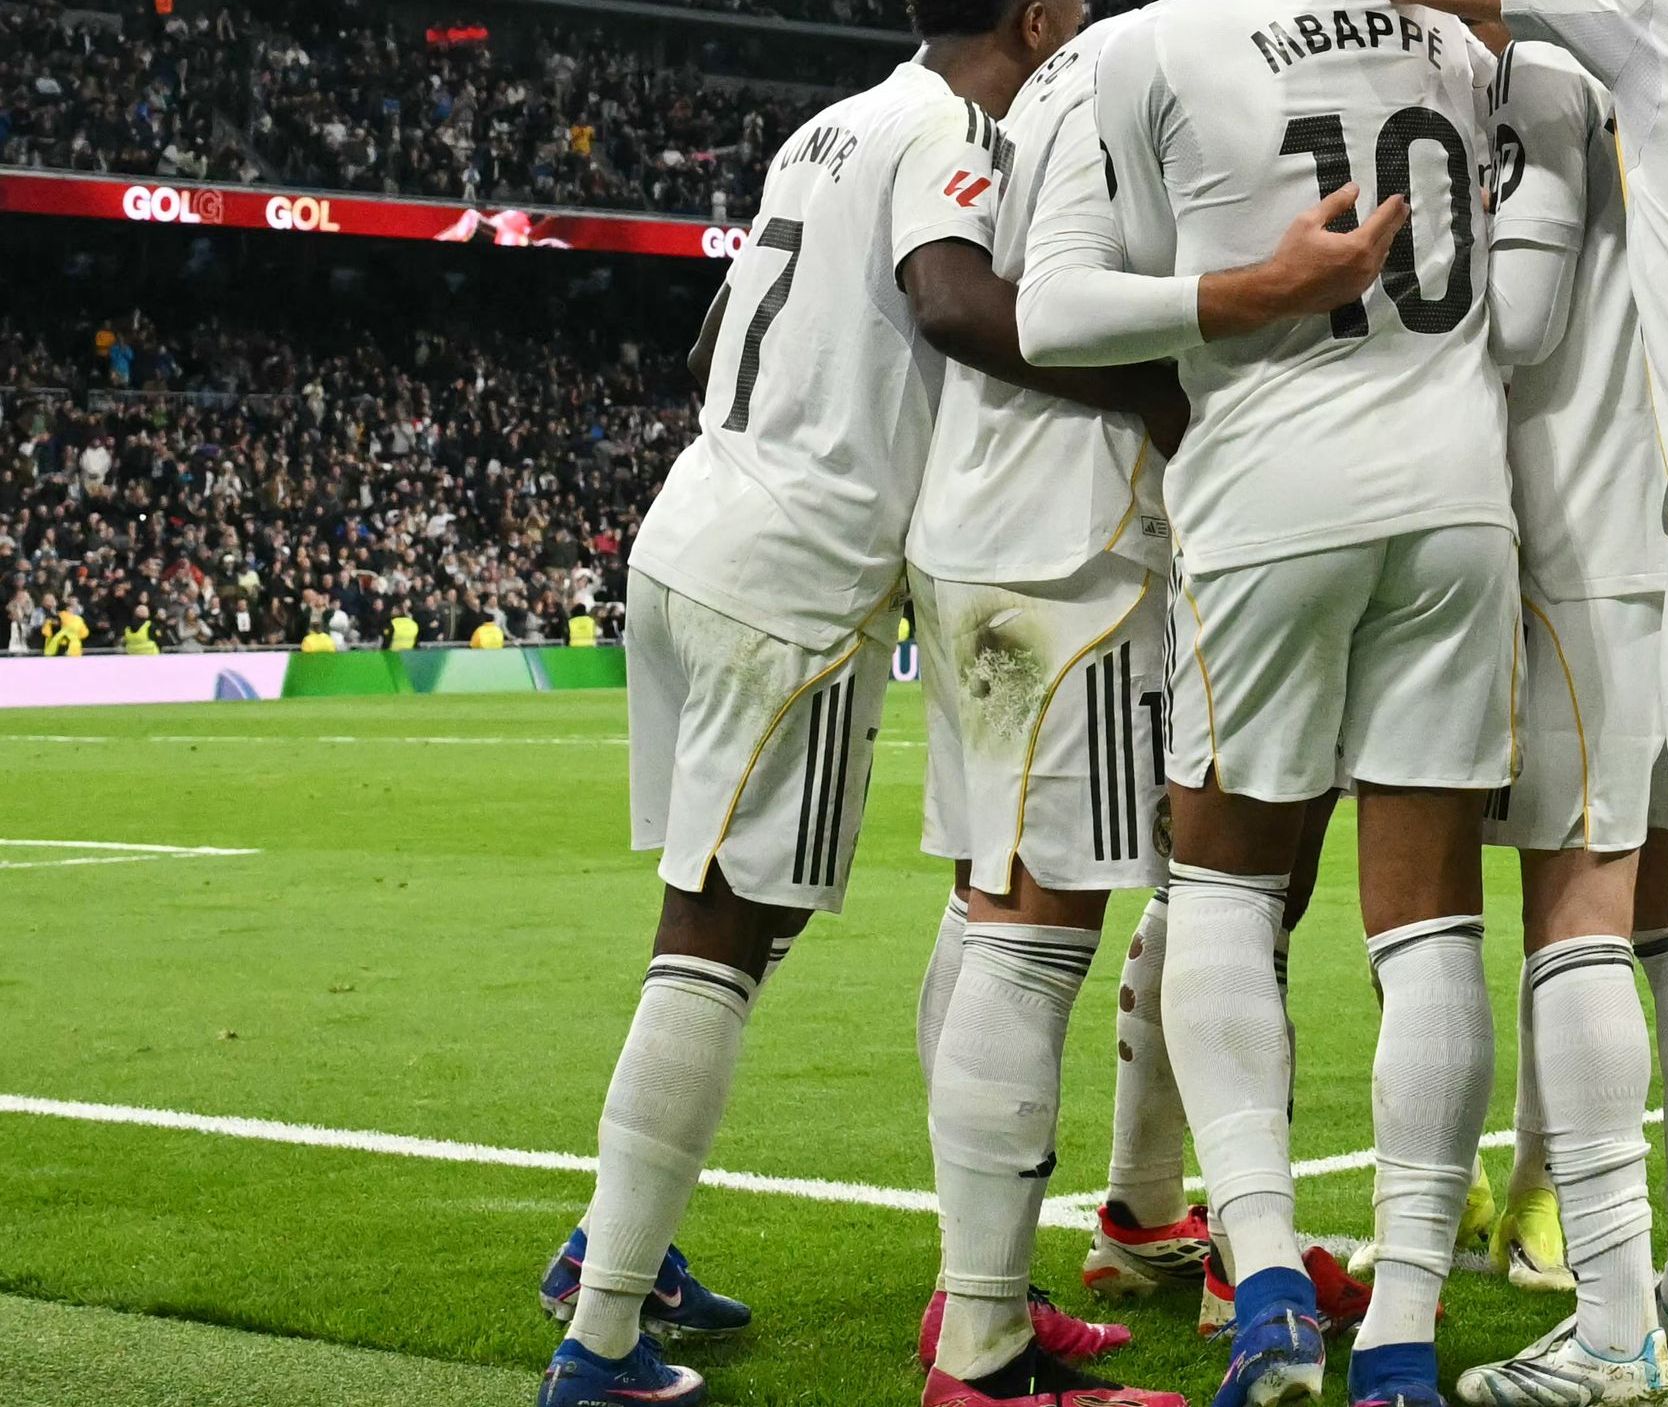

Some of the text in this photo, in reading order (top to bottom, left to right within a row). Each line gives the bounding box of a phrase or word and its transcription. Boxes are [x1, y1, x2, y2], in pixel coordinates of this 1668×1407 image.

[1250, 9, 1443, 74] MBAPPÉ
[265, 196, 341, 233] GOL
[702, 228, 748, 259] GO
[1279, 106, 1475, 340] 10
[722, 217, 804, 433] 7
